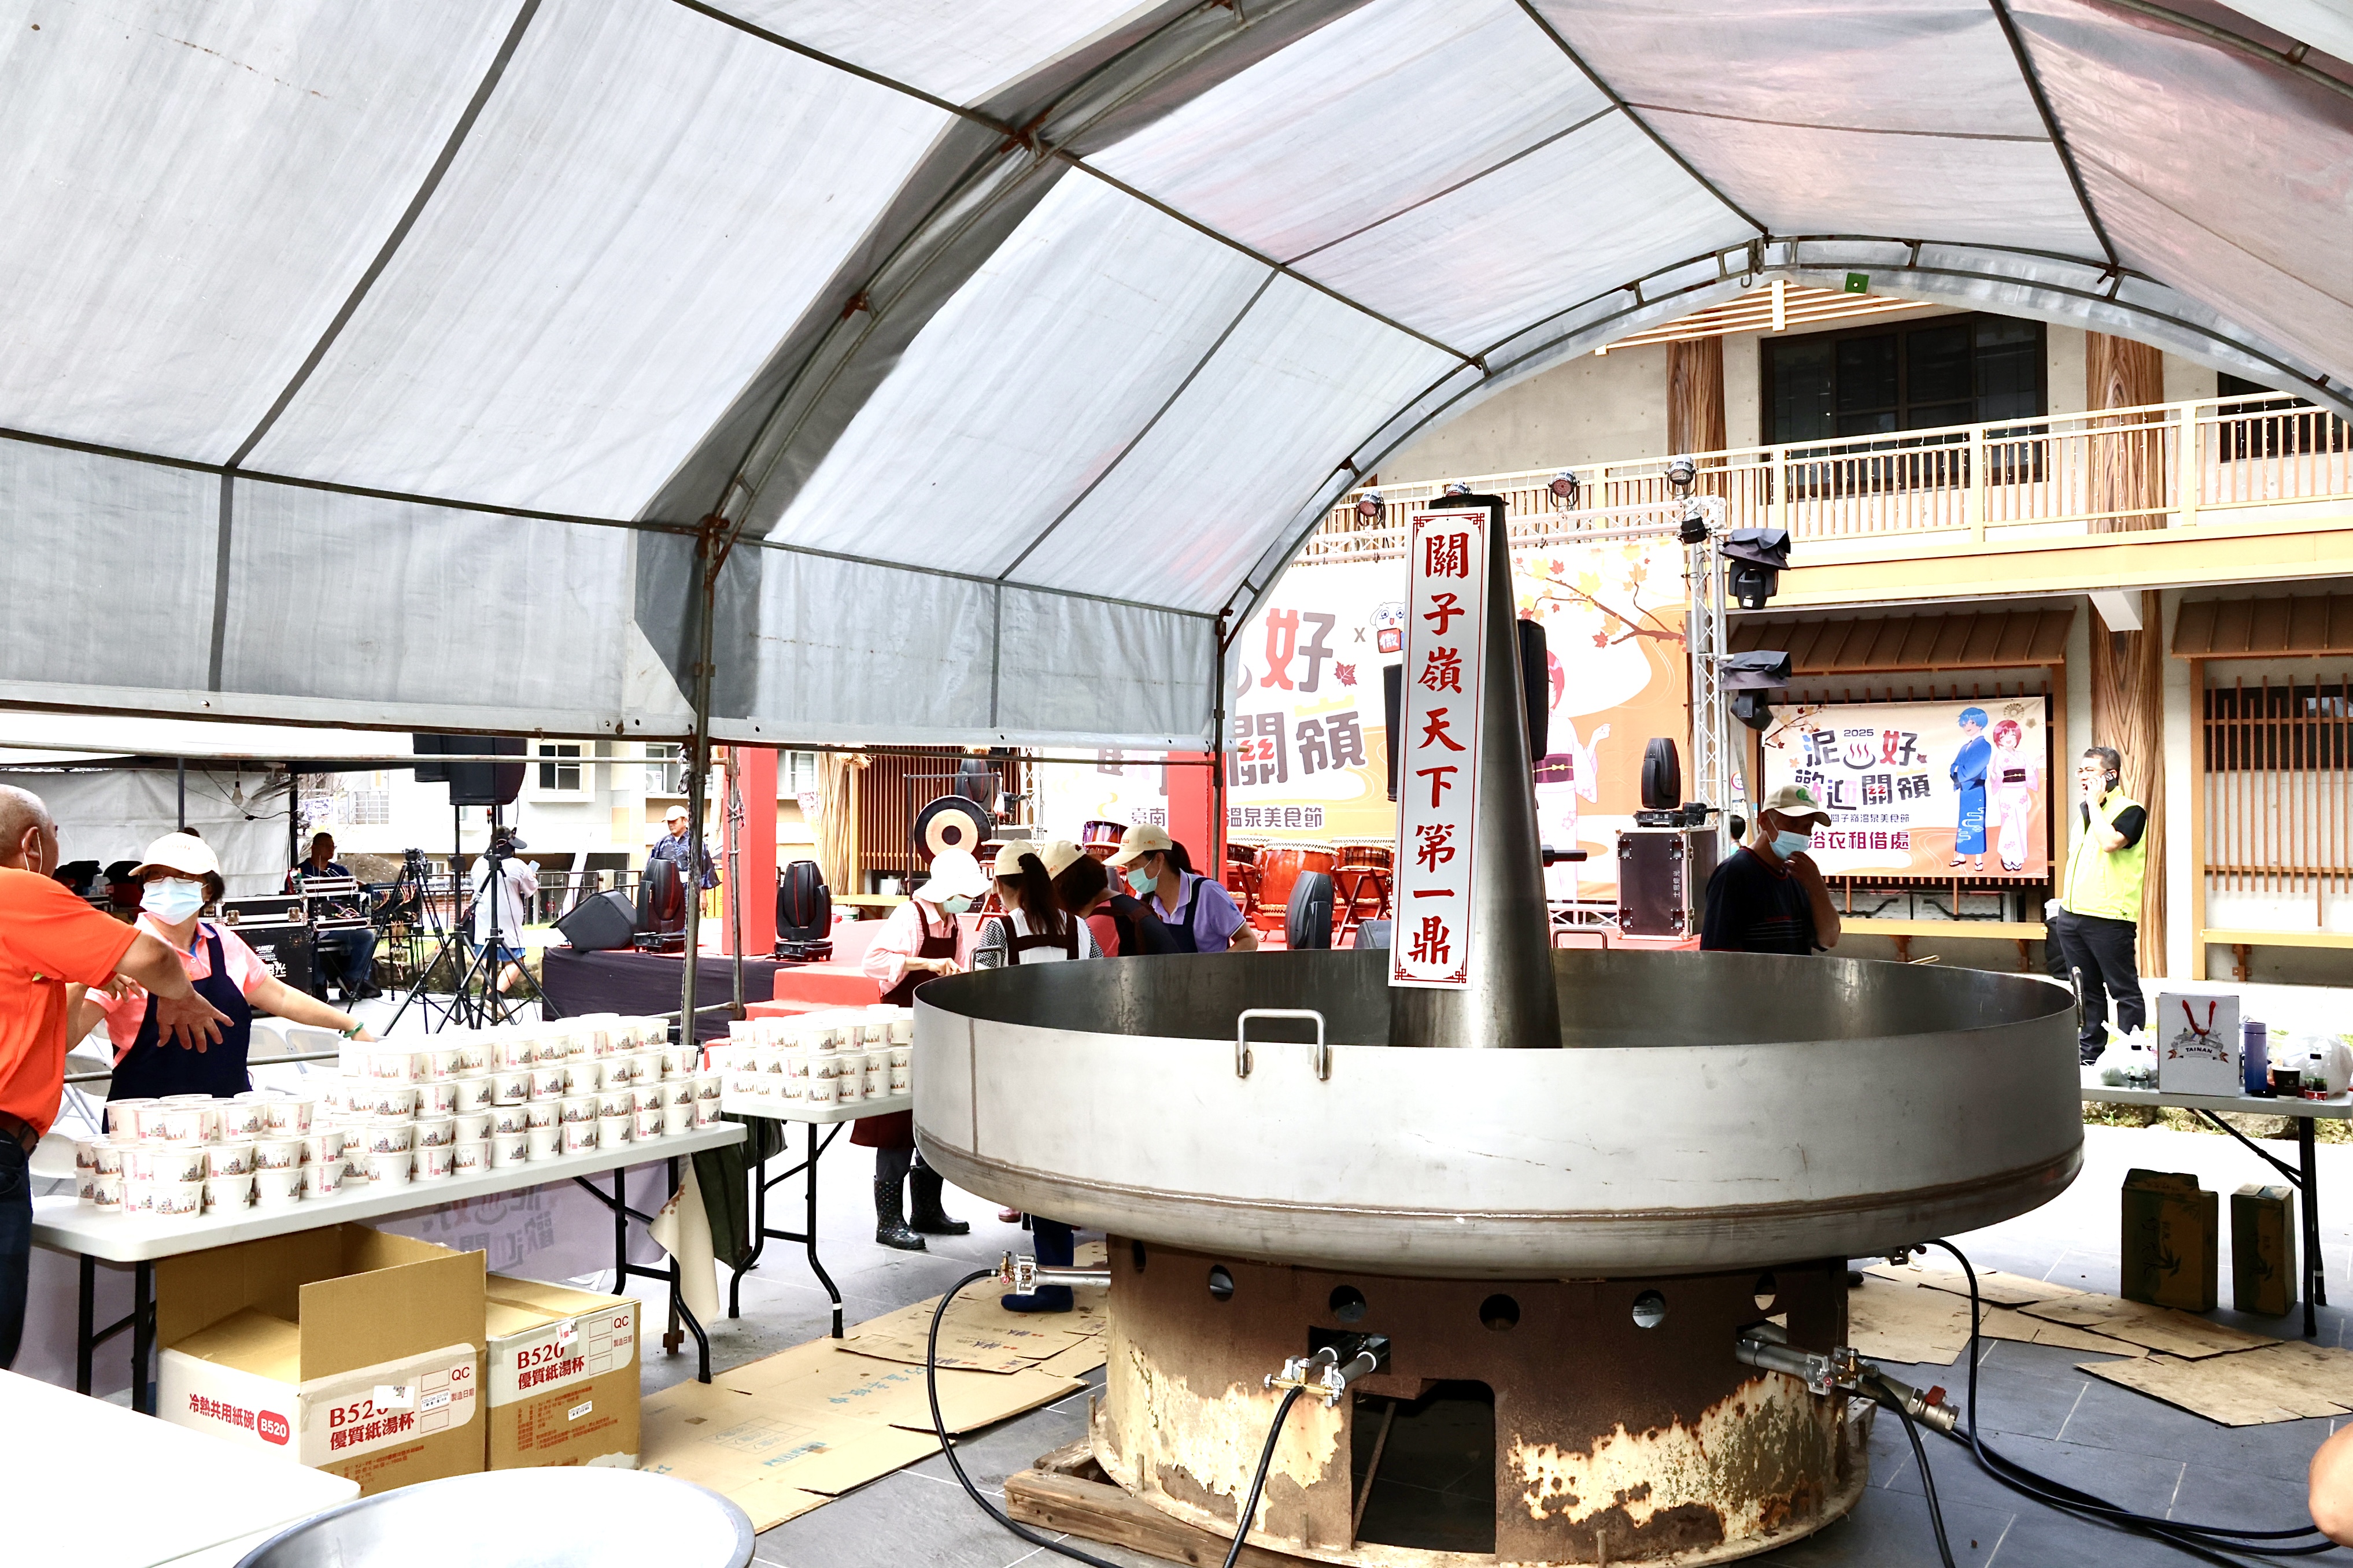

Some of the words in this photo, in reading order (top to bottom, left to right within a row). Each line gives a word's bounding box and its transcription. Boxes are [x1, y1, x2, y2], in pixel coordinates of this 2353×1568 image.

[1260, 608, 1335, 693] 好
[1408, 532, 1469, 964] 關子嶺天下第一鼎
[1828, 813, 1909, 823] 關子嶺溫泉美食節
[1808, 831, 1909, 849] 浴衣租借處
[614, 1316, 629, 1328] QC
[614, 1335, 633, 1347] 製造日期
[518, 1341, 564, 1369] B520
[452, 1367, 470, 1381] QC
[518, 1355, 585, 1390] 優質紙湯杯
[451, 1388, 474, 1401] 製造日期
[189, 1393, 254, 1430] 冷熱共用紙碗
[261, 1418, 286, 1437] B520
[330, 1411, 415, 1451] 優質紙湯杯
